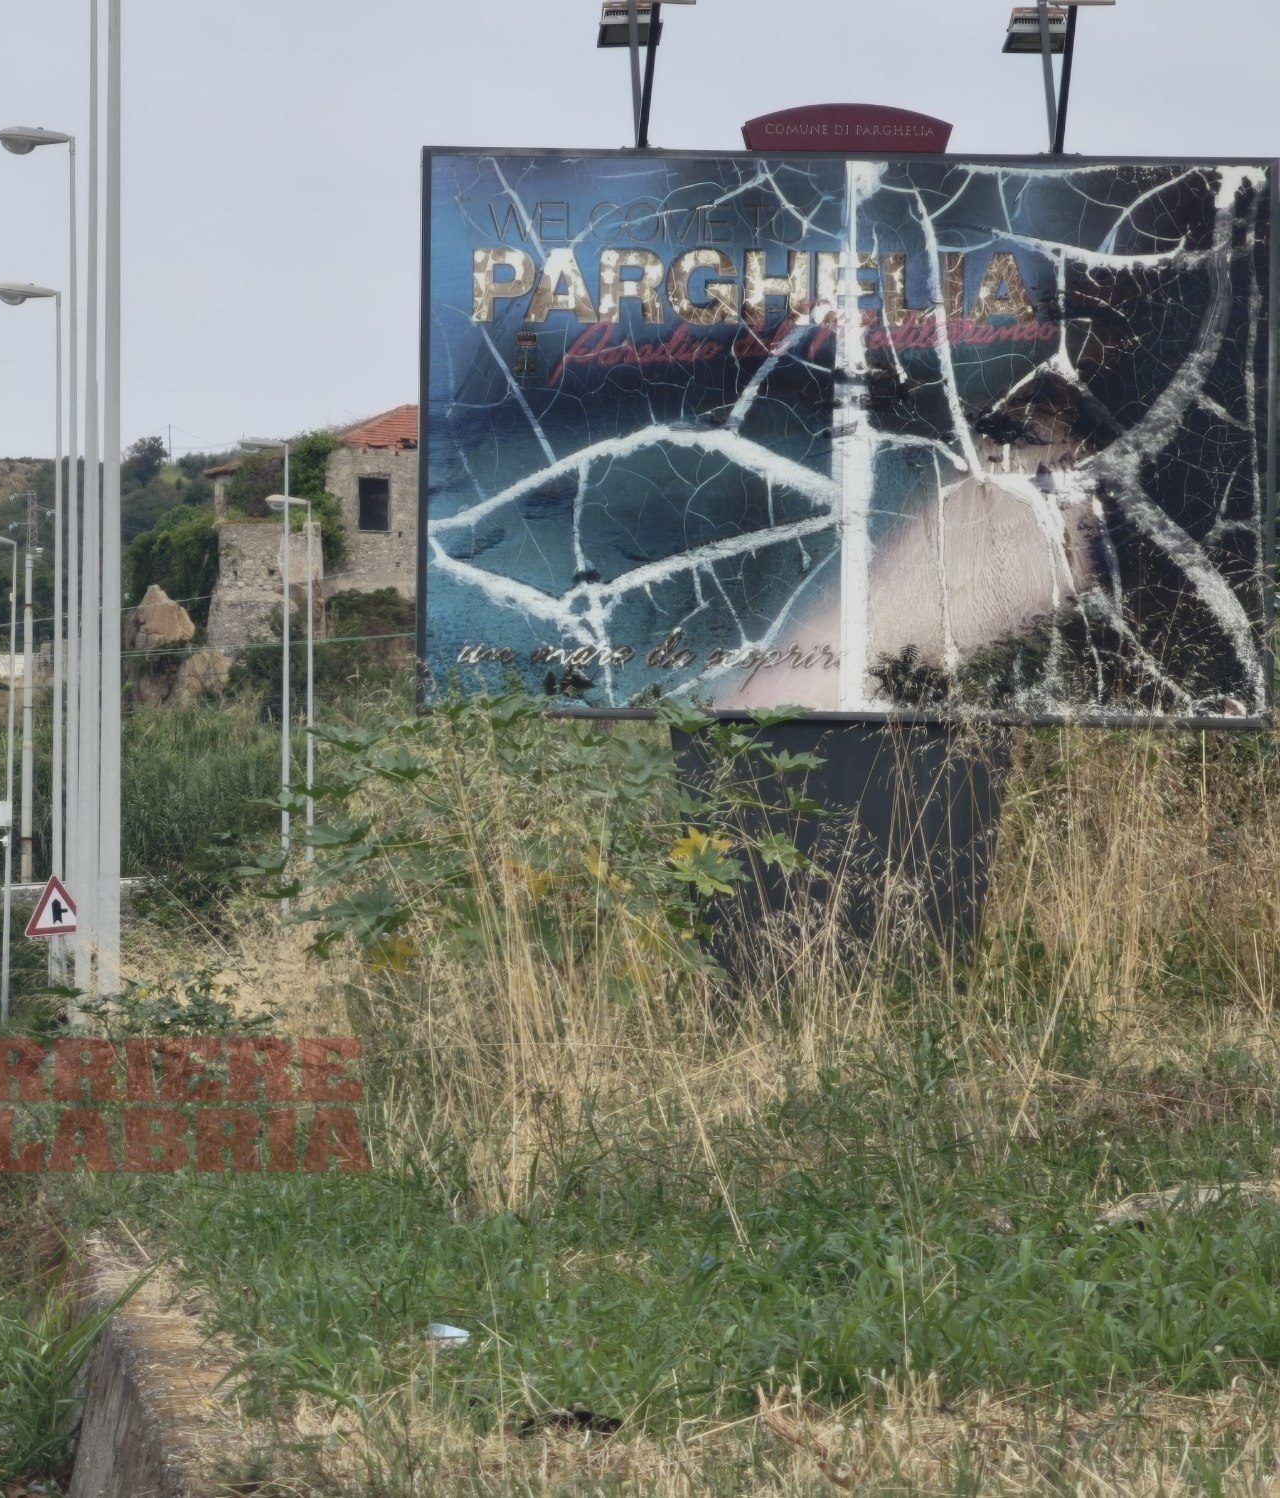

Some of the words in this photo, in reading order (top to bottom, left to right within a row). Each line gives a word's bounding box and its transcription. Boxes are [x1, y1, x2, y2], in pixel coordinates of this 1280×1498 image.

[765, 123, 829, 136] COMUNE
[834, 125, 850, 136] DI
[856, 124, 935, 137] PARGHELIA
[488, 201, 729, 244] WELCOME
[744, 203, 806, 243] TO
[471, 247, 1035, 326] PARGHELIA
[549, 320, 721, 386] Paradiso
[457, 641, 519, 664] un
[530, 641, 635, 668] mare
[646, 626, 697, 669] da
